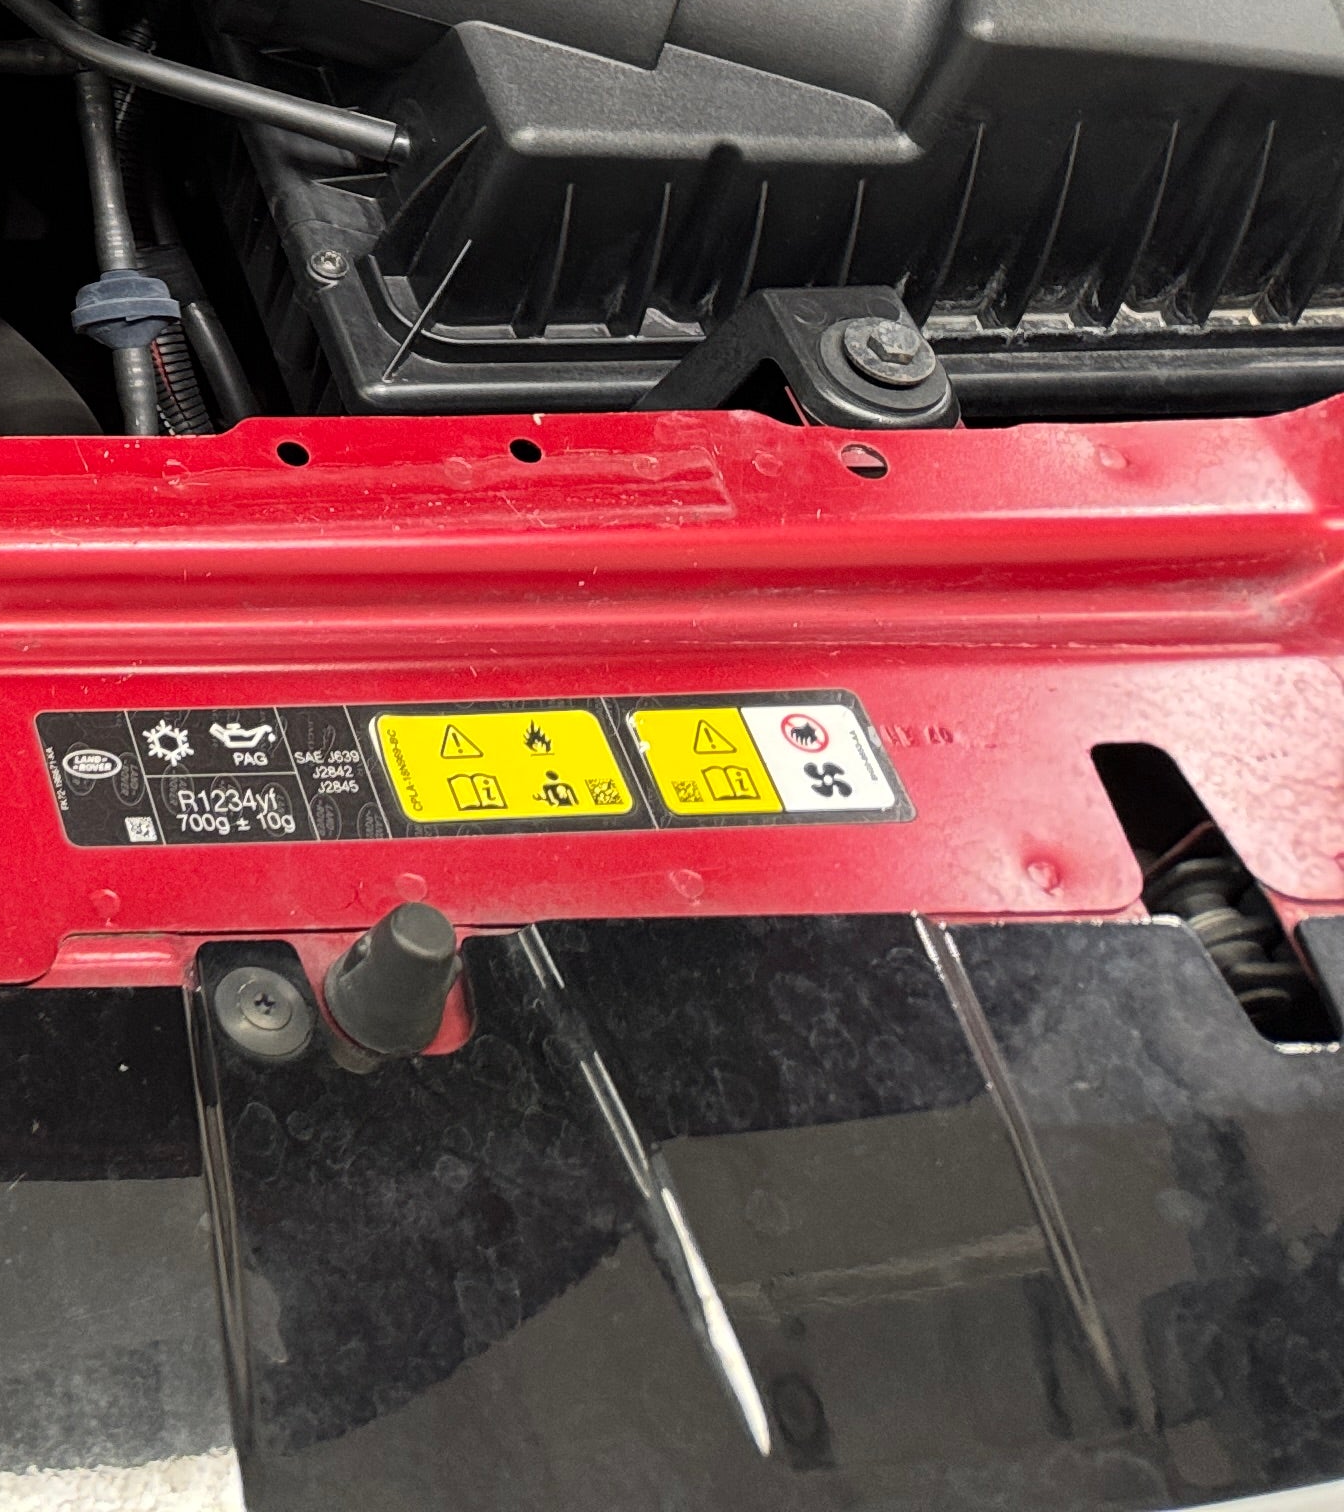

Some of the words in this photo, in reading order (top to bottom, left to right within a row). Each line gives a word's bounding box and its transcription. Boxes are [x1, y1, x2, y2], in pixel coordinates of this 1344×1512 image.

[232, 751, 268, 766] PAG
[294, 751, 324, 764] SAE
[327, 749, 360, 764] J639
[312, 765, 354, 779] J2842
[317, 780, 360, 794] J2845
[177, 788, 279, 816] R1234yf
[175, 813, 231, 835] 700g
[256, 811, 296, 834] 10g
